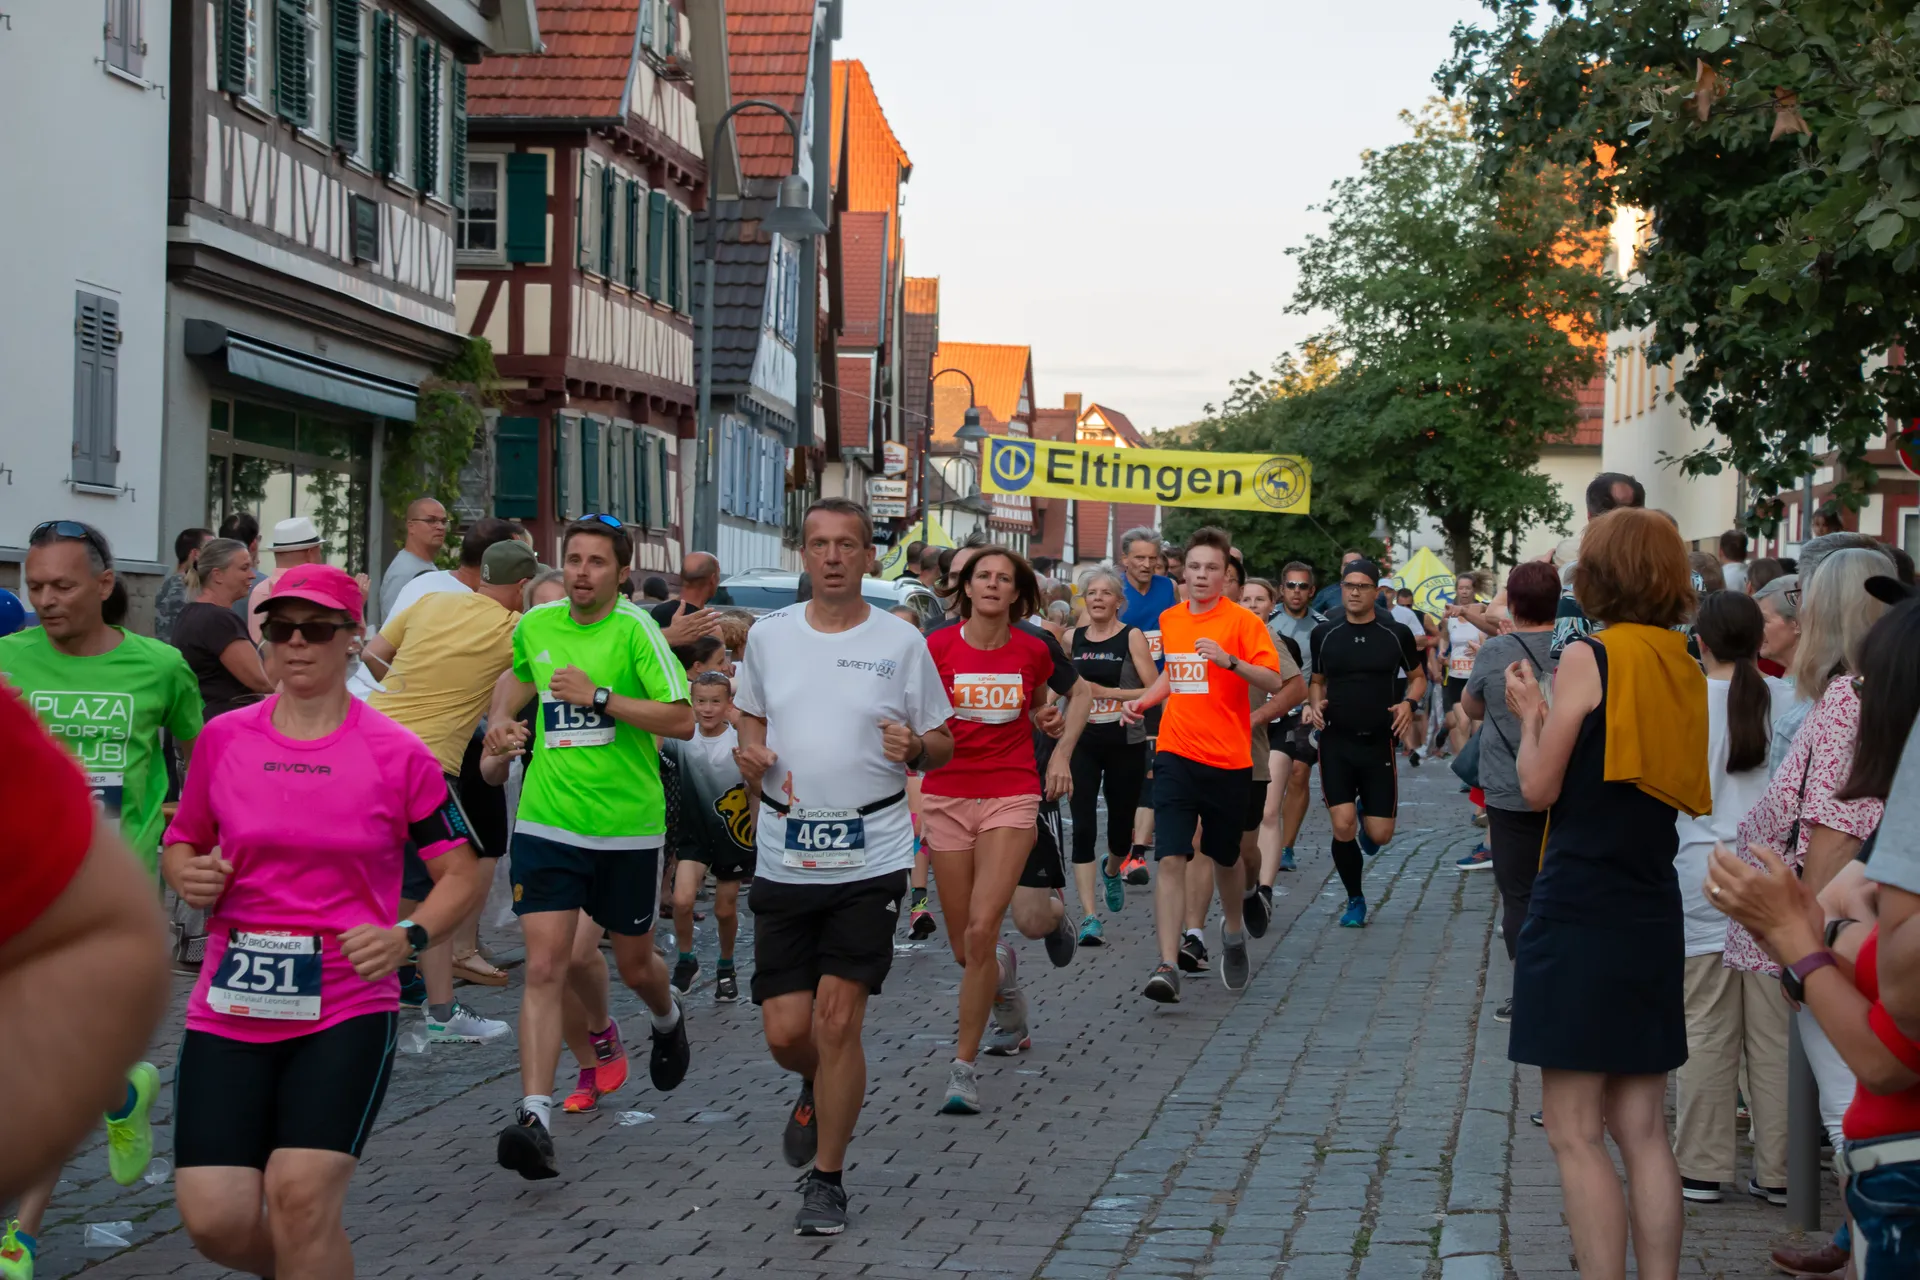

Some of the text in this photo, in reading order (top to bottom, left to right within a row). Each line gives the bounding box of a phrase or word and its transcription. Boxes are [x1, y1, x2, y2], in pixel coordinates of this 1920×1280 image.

[1046, 447, 1243, 502] Eltingen
[872, 527, 893, 540] sky
[1168, 663, 1205, 681] 1120
[959, 685, 1020, 708] 1304
[35, 696, 128, 721] PLAZA
[554, 703, 601, 729] 153
[49, 724, 126, 740] PORTS
[263, 761, 331, 776] GIVOVA
[808, 810, 848, 818] BRÜCKNER
[797, 823, 851, 849] 462
[248, 937, 302, 950] BRÜCKNER
[227, 952, 299, 993] 251
